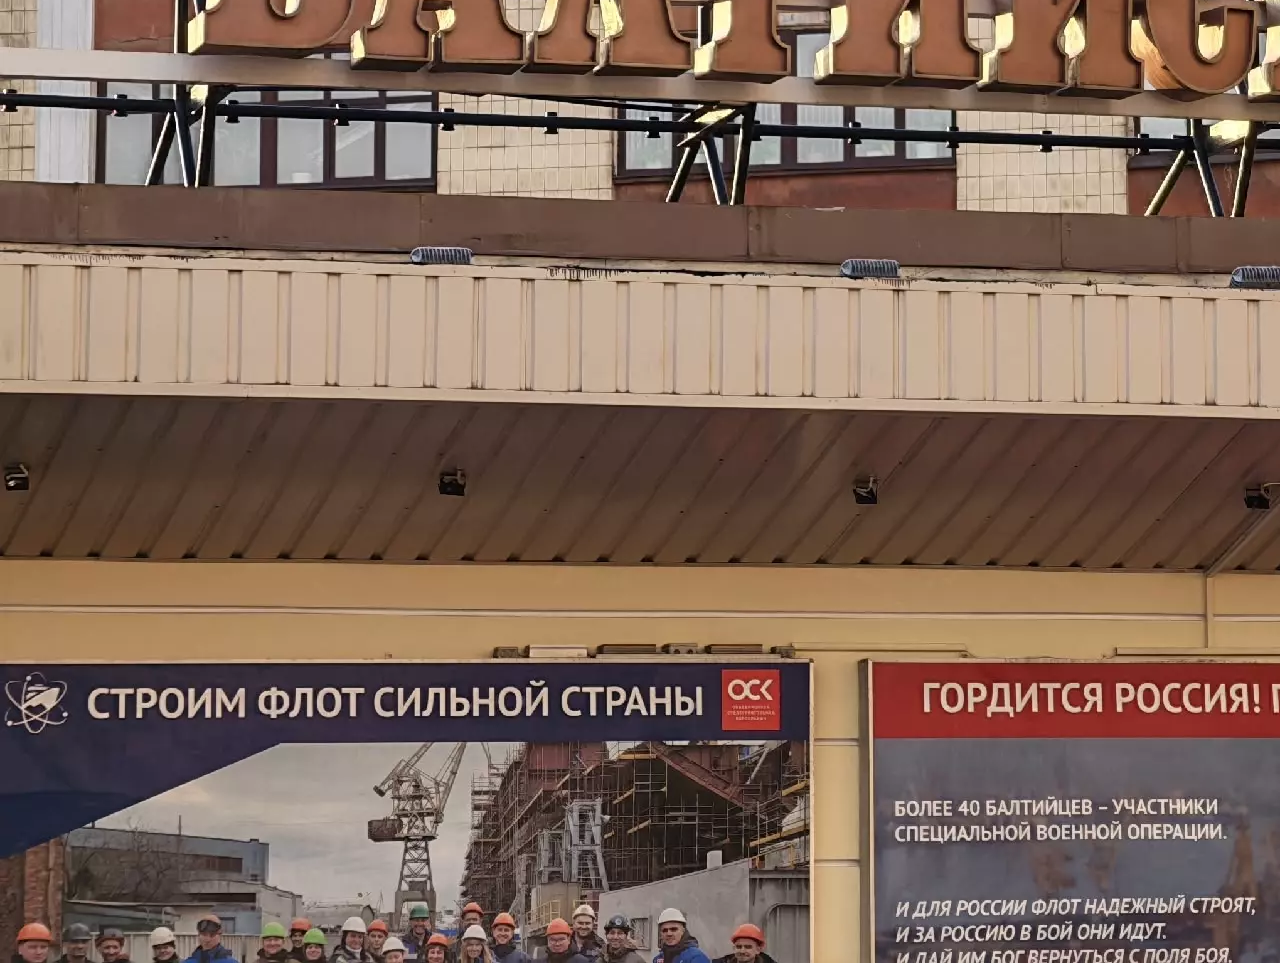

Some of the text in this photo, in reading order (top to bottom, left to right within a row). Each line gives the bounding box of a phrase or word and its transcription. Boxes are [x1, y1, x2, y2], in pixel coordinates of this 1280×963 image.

[87, 679, 703, 719] СТРОИМ ФЛОТ СИЛЬНОЙ СТРАНЫ
[727, 679, 774, 701] ОСК
[922, 682, 1103, 718] ГОРДИТСЯ
[1115, 683, 1261, 714] РОССИЯ!
[894, 800, 953, 817] БОЛЕЕ
[958, 800, 980, 816] 40
[985, 796, 1092, 818] БАЛТИЙЦЕВ
[1112, 798, 1218, 816] УЧАСТНИКИ
[894, 821, 1227, 844] СПЕЦИАЛЬНОЙ ВОЕННОЙ ОПЕРАЦИИ.
[896, 894, 1256, 920] И ДЛЯ РОССИИ ФЛОТ НАДЕЖНЫЙ СТРОЯТ,
[896, 921, 1167, 943] И ЗА РОССИЮ В БОЙ ОНИ ИДУТ.
[896, 947, 1233, 963] И ДАЙ ИМ БОГ ВЕРНУТЬСЯ С ПОЛЯ БОЯ.
